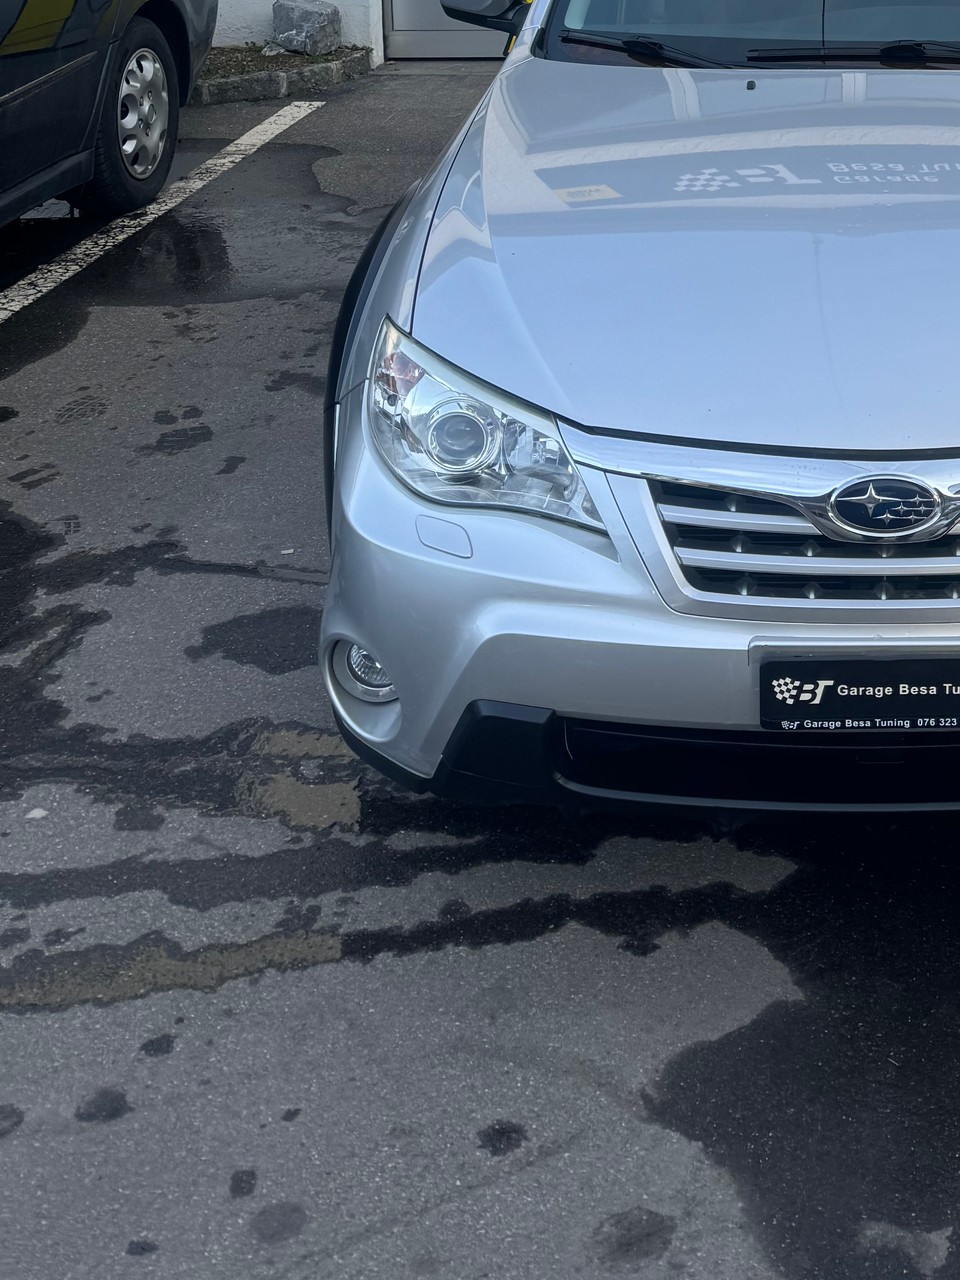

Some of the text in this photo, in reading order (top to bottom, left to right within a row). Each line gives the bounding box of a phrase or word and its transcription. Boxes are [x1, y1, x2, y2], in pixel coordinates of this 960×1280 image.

[799, 680, 834, 704] BT
[837, 684, 893, 698] Garage
[899, 683, 937, 695] Besa
[803, 720, 841, 729] Garage
[845, 719, 871, 727] Besa
[874, 718, 910, 728] Tuning
[917, 718, 936, 726] 076
[939, 718, 957, 726] 323
